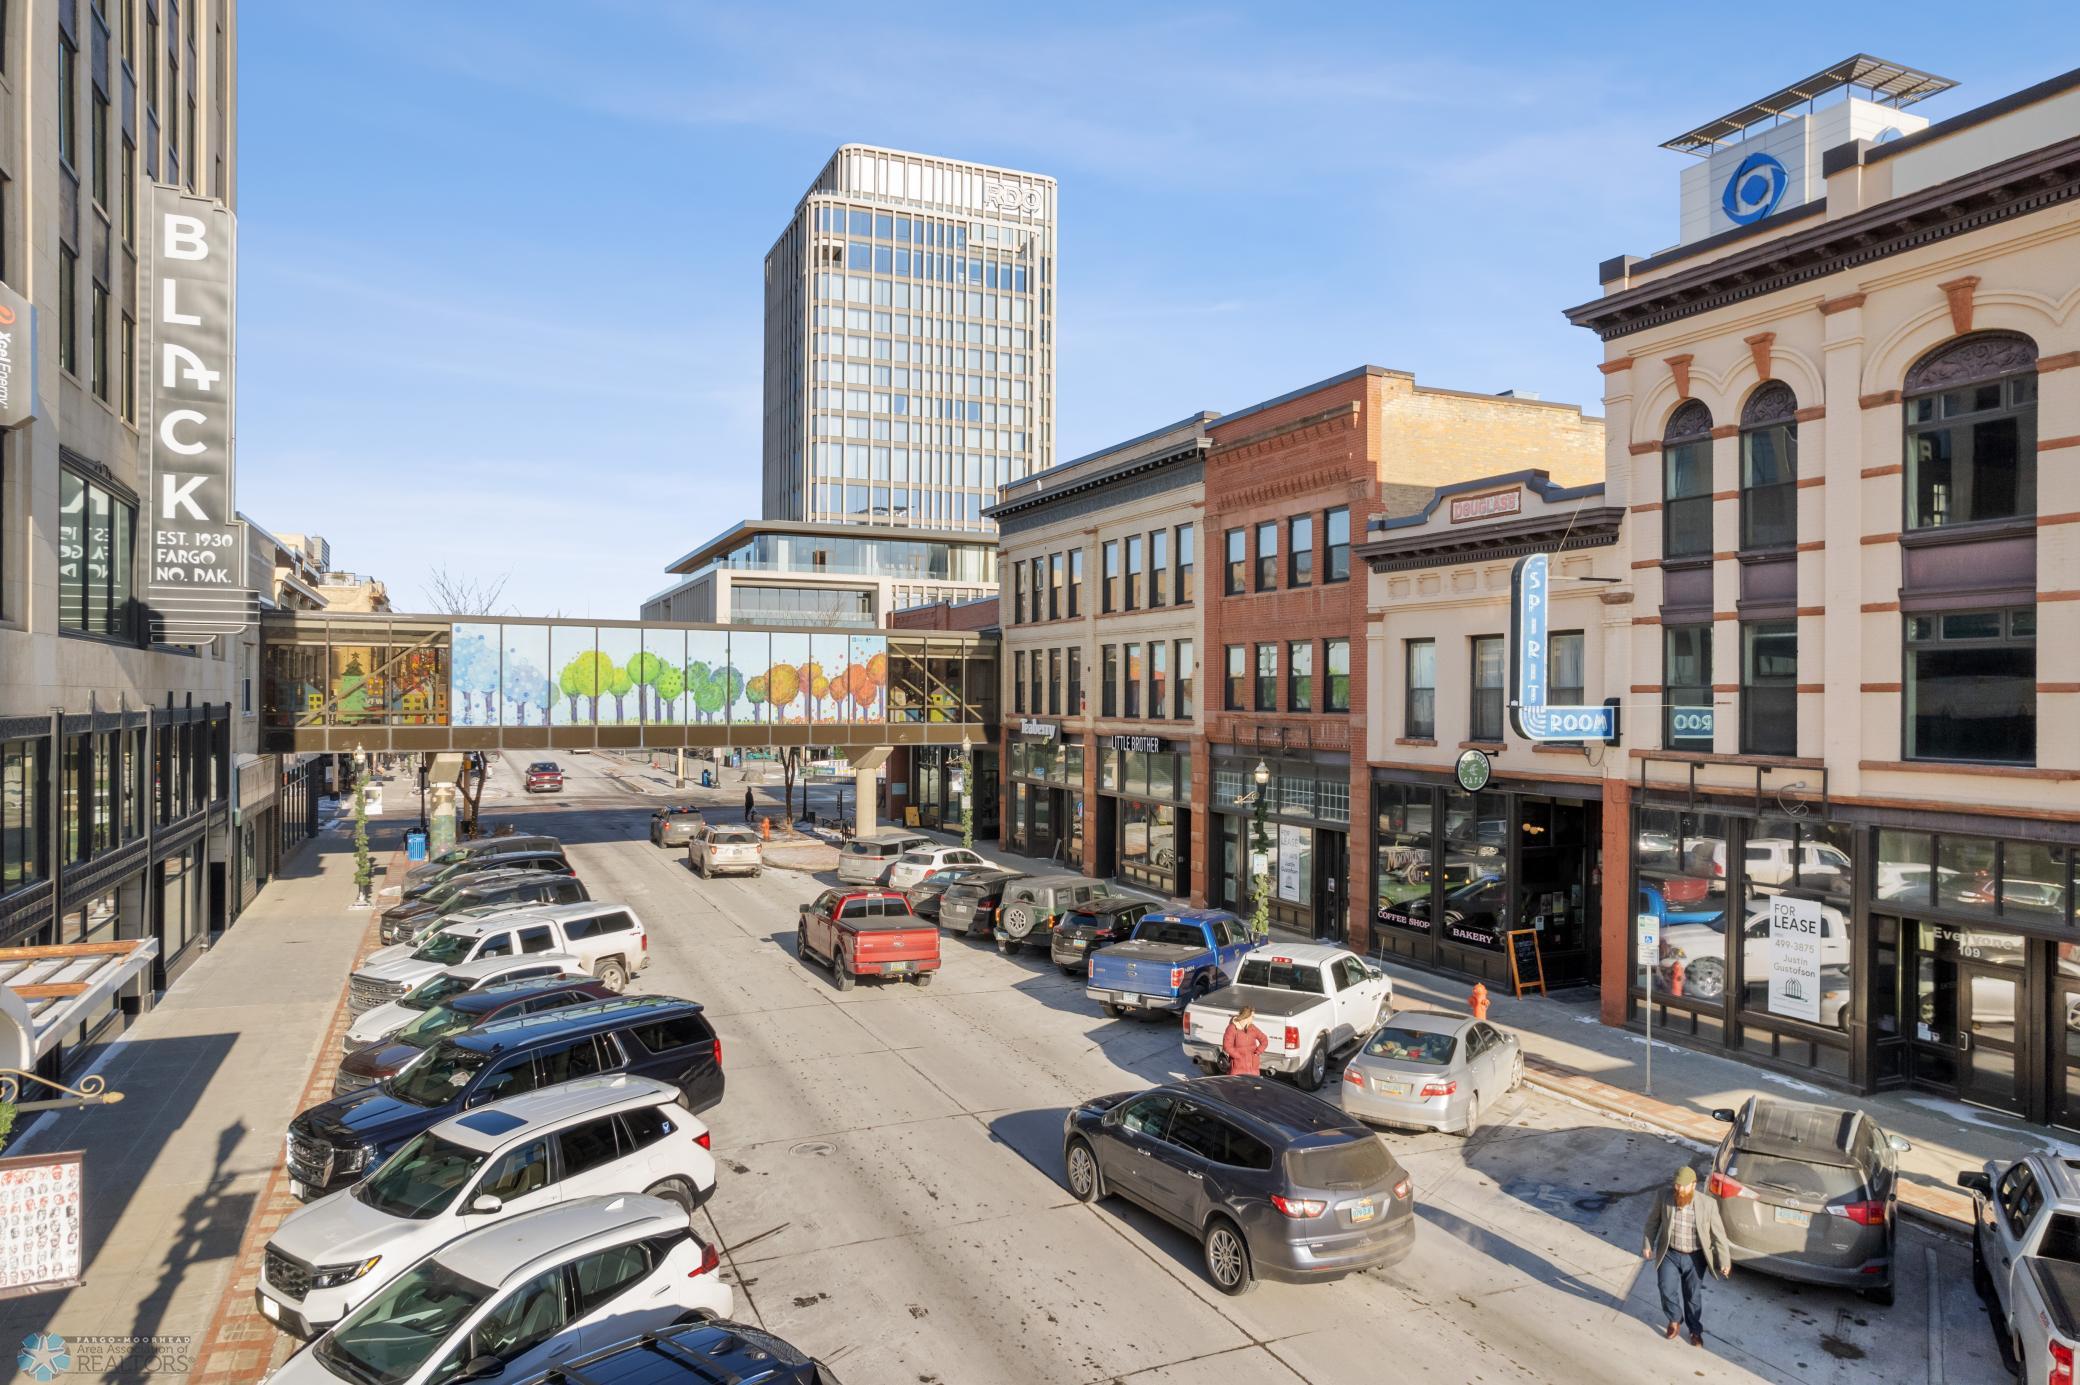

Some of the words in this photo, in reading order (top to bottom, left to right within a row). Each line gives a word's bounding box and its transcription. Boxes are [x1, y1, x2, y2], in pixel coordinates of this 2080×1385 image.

[984, 181, 1042, 213] RDO
[160, 213, 220, 521] BLACK
[157, 530, 189, 546] EST.
[195, 532, 233, 547] 1930
[157, 548, 217, 565] FARGO
[157, 566, 188, 582] NO.
[194, 567, 232, 583] DAK.
[1528, 571, 1541, 702] SPIRIT
[1020, 718, 1056, 739] Teaberry
[1550, 713, 1608, 732] ROOM
[1111, 735, 1130, 751] LITTLE
[1131, 736, 1159, 752] BROTHER
[1386, 850, 1425, 871] MOONRISE
[1774, 903, 1796, 916] FOR
[1378, 911, 1407, 924] COFFEE
[1408, 917, 1431, 929] SHOP
[1774, 915, 1817, 934] LEASE
[1453, 928, 1493, 944] BAKERY
[1775, 939, 1815, 954] 499-3875
[1958, 946, 1981, 958] 109
[1783, 954, 1808, 967] Justin
[1773, 962, 1816, 978] Gustofson
